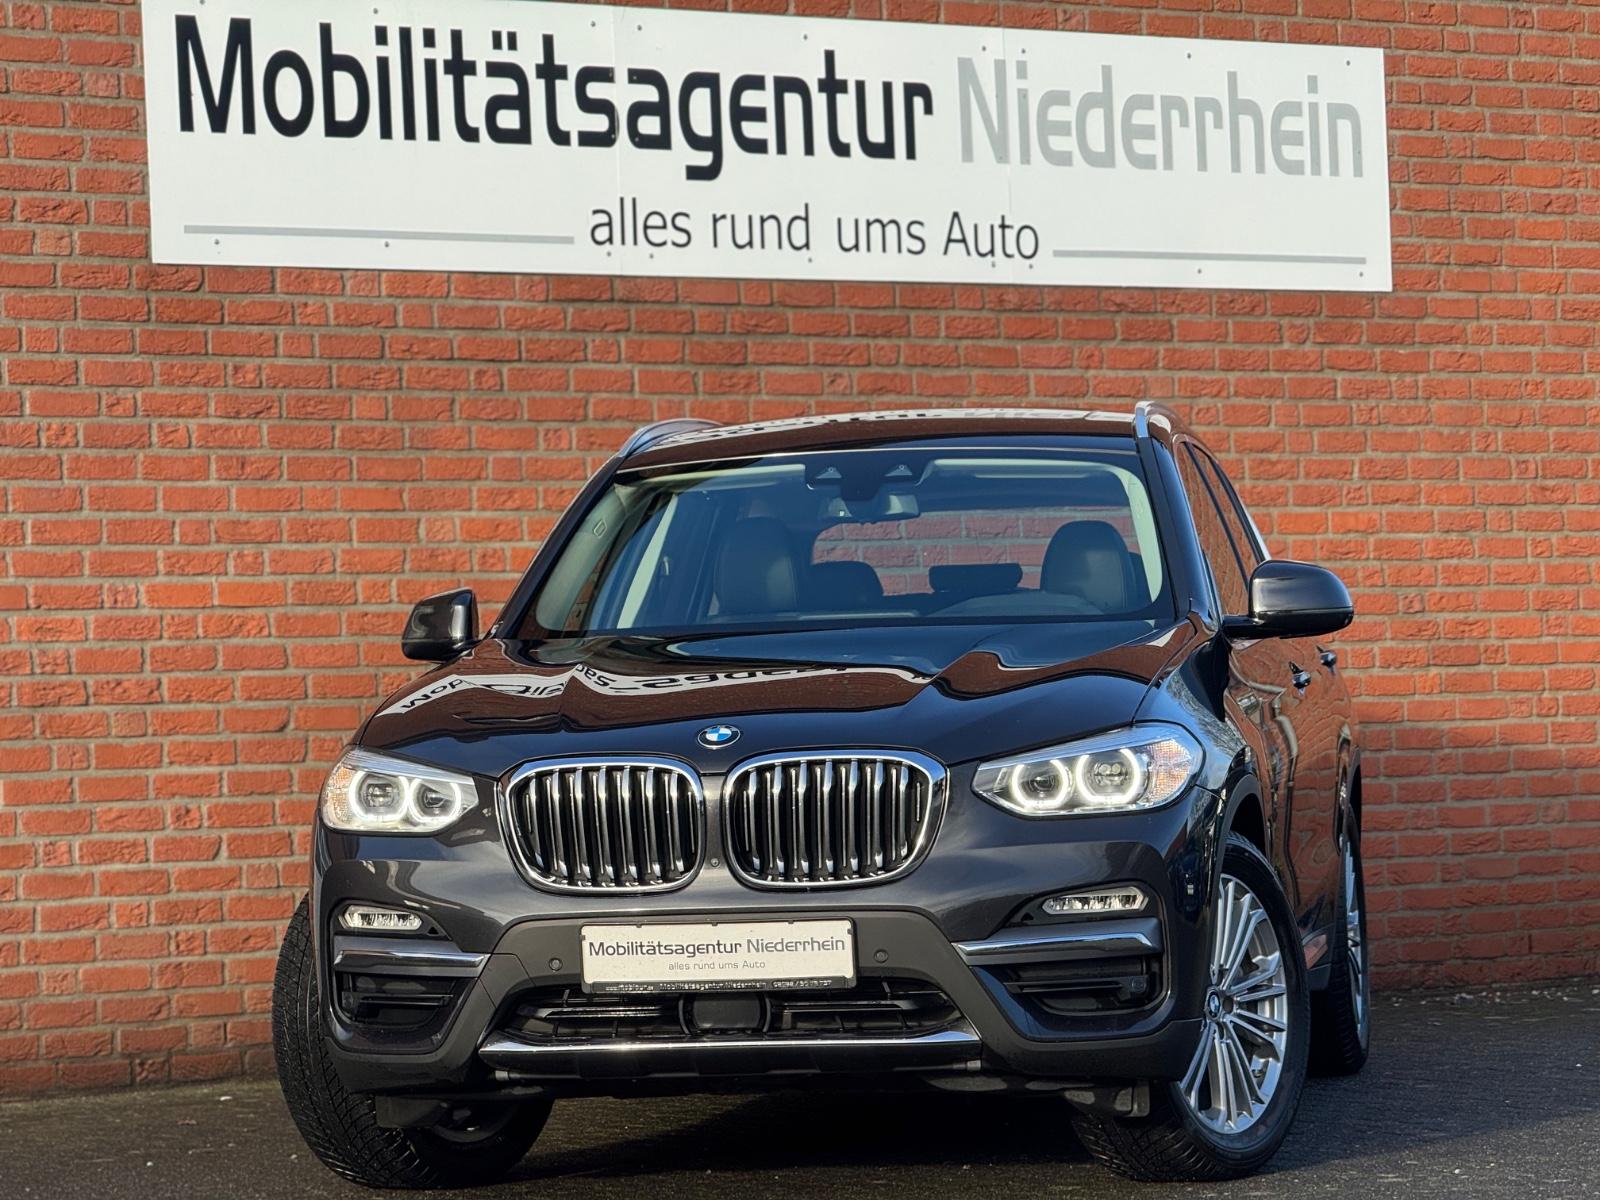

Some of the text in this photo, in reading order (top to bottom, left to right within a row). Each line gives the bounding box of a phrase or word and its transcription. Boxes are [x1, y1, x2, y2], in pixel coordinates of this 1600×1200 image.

[175, 14, 1364, 181] Mobilitätsagentur Niederrhein
[590, 196, 1039, 260] alles rund ums Auto
[588, 936, 845, 958] Mobilitätsagentur Niederrhein
[668, 959, 766, 971] alles rund ums Auto
